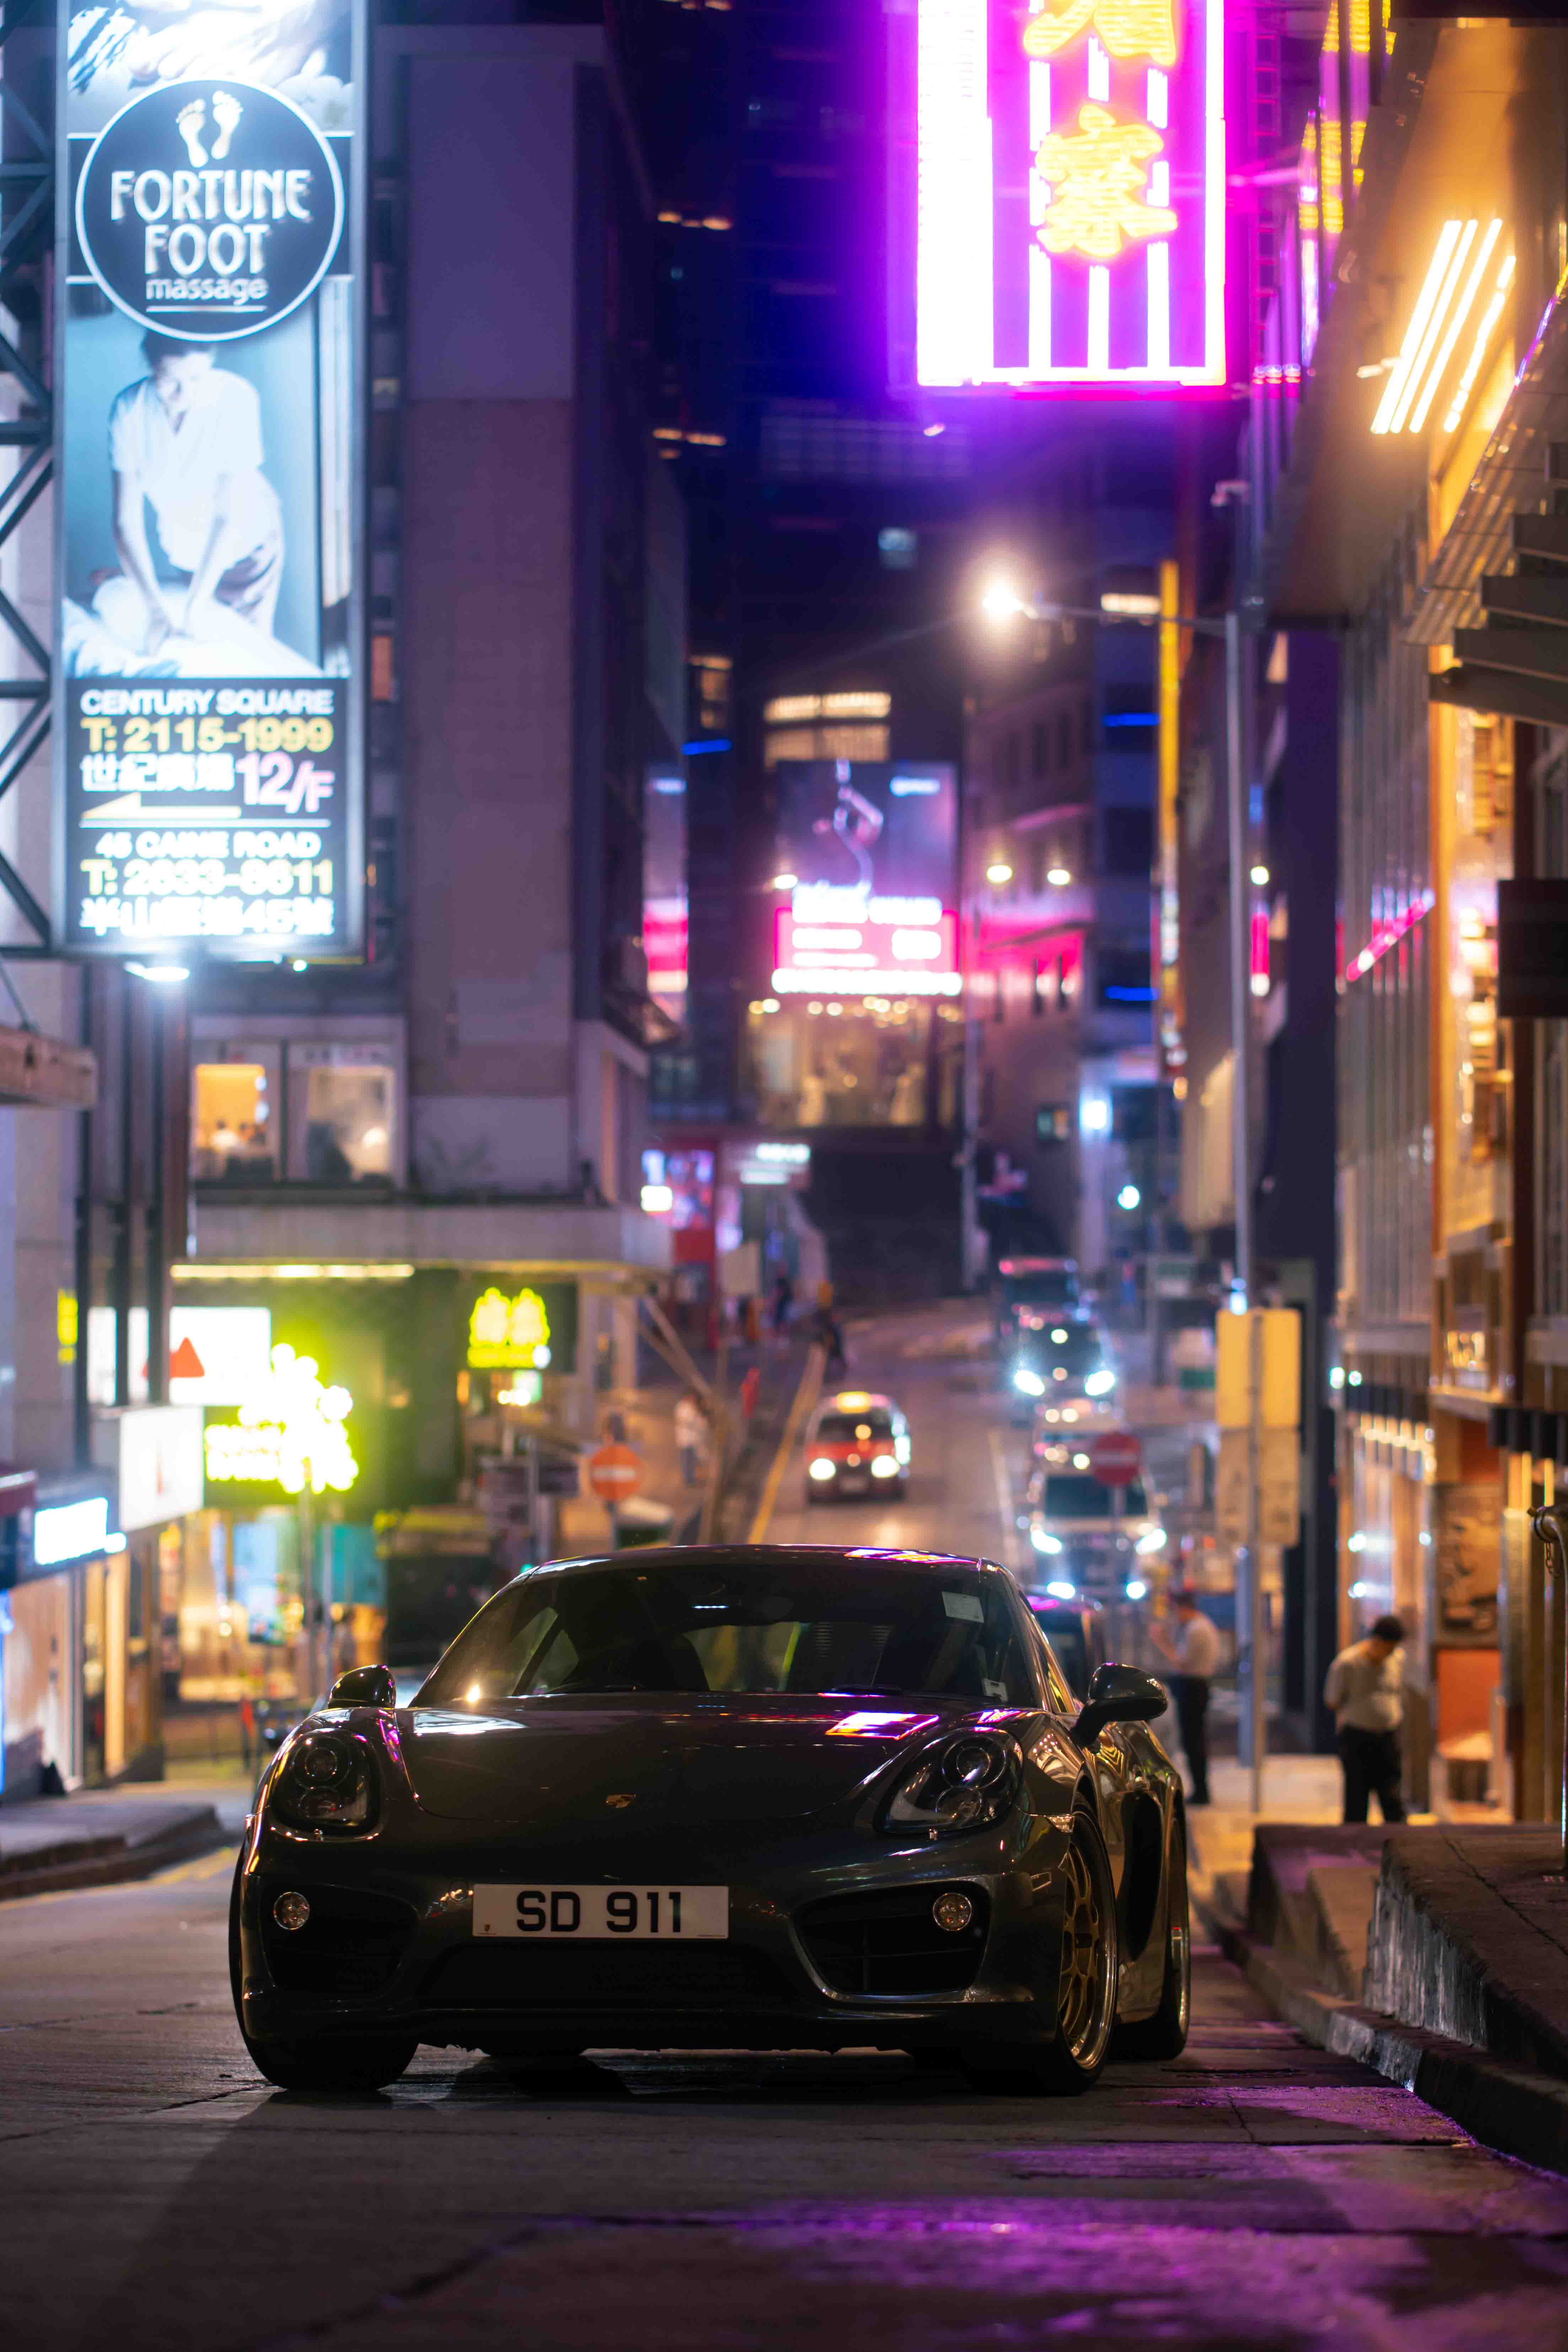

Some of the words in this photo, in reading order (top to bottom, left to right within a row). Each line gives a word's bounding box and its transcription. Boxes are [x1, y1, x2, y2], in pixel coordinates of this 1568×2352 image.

[111, 170, 313, 222] FORTUNE
[145, 223, 272, 275] FOOT
[146, 278, 268, 305] massage
[80, 689, 214, 715] CENTURY
[216, 689, 334, 715] SQUARE
[80, 717, 117, 752] T:
[123, 717, 333, 752] 2115-1999
[236, 752, 335, 813] 12/F
[233, 831, 322, 859] ROAD
[80, 859, 118, 895] T:
[517, 1891, 580, 1932] SD
[606, 1891, 681, 1933] 911
